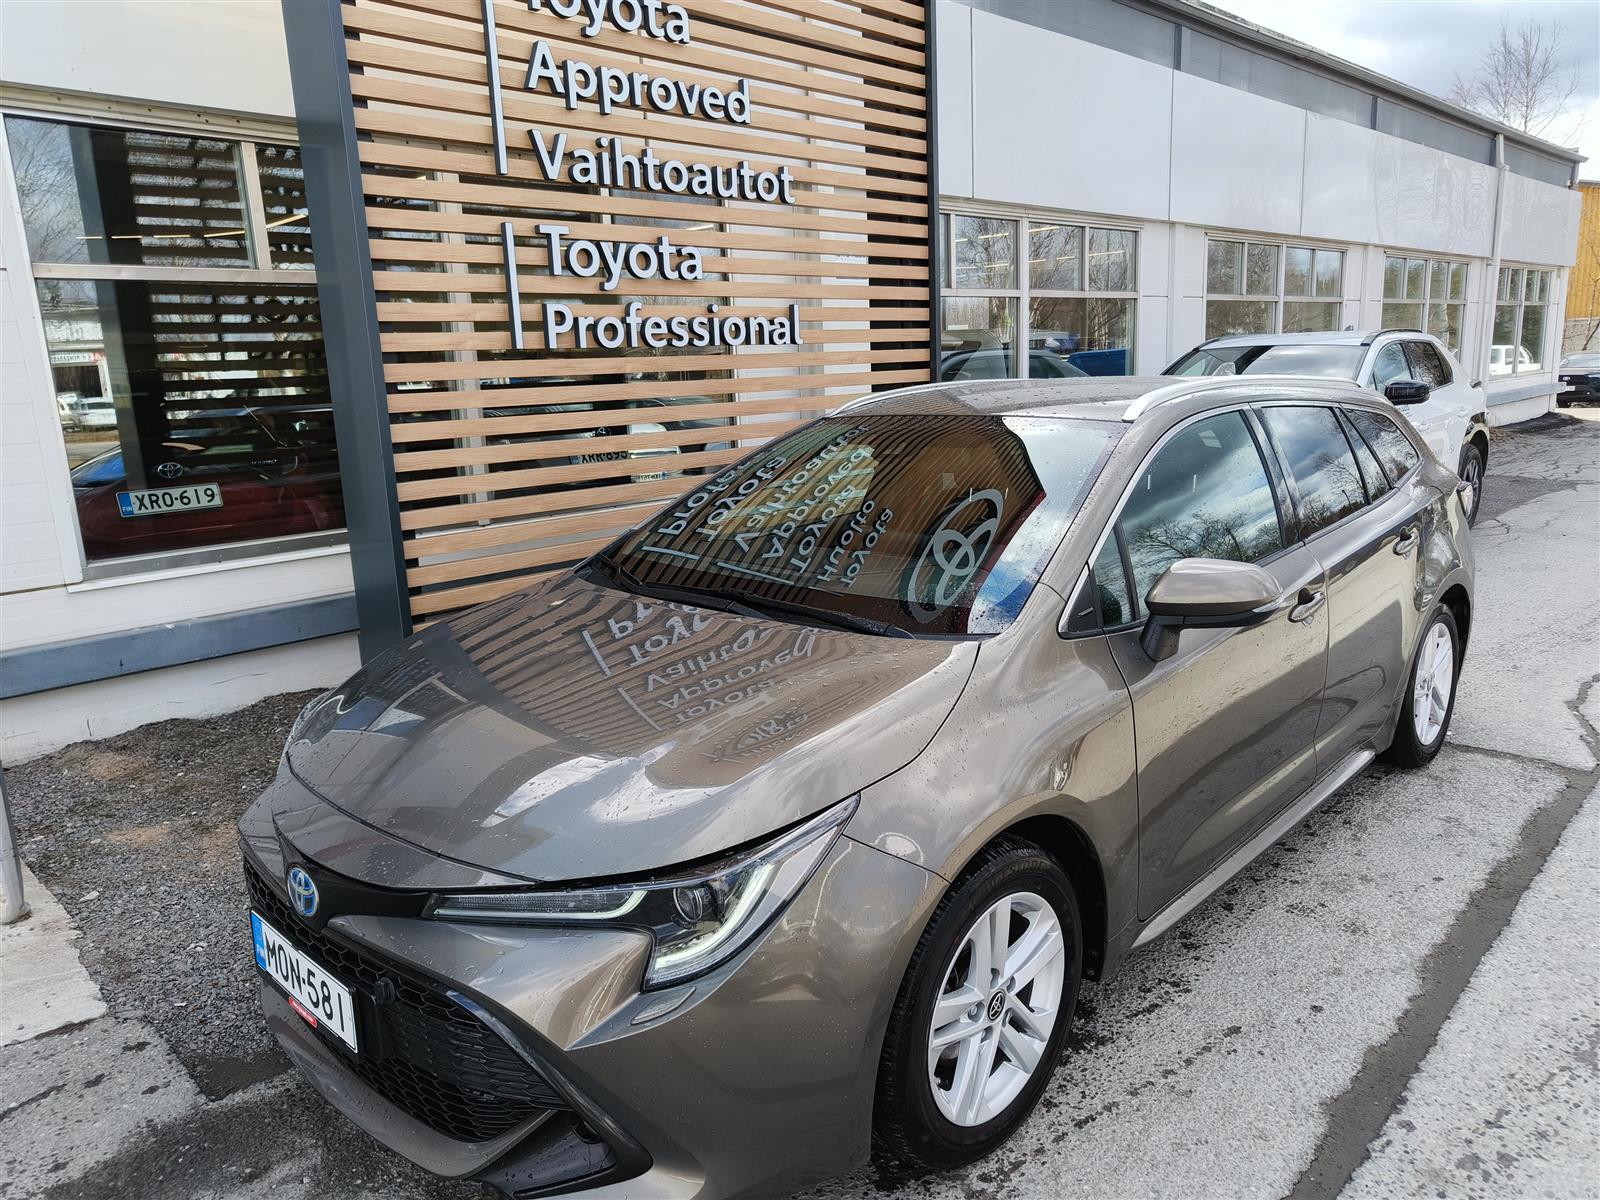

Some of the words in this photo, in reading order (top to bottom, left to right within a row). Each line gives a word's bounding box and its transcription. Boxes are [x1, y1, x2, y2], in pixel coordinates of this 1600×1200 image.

[525, 40, 750, 124] Approved
[528, 129, 796, 204] Vaihtoautot
[535, 224, 703, 291] Toyota
[543, 302, 803, 349] Professional
[135, 487, 216, 511] XRO-619
[265, 931, 345, 1032] MON-581
